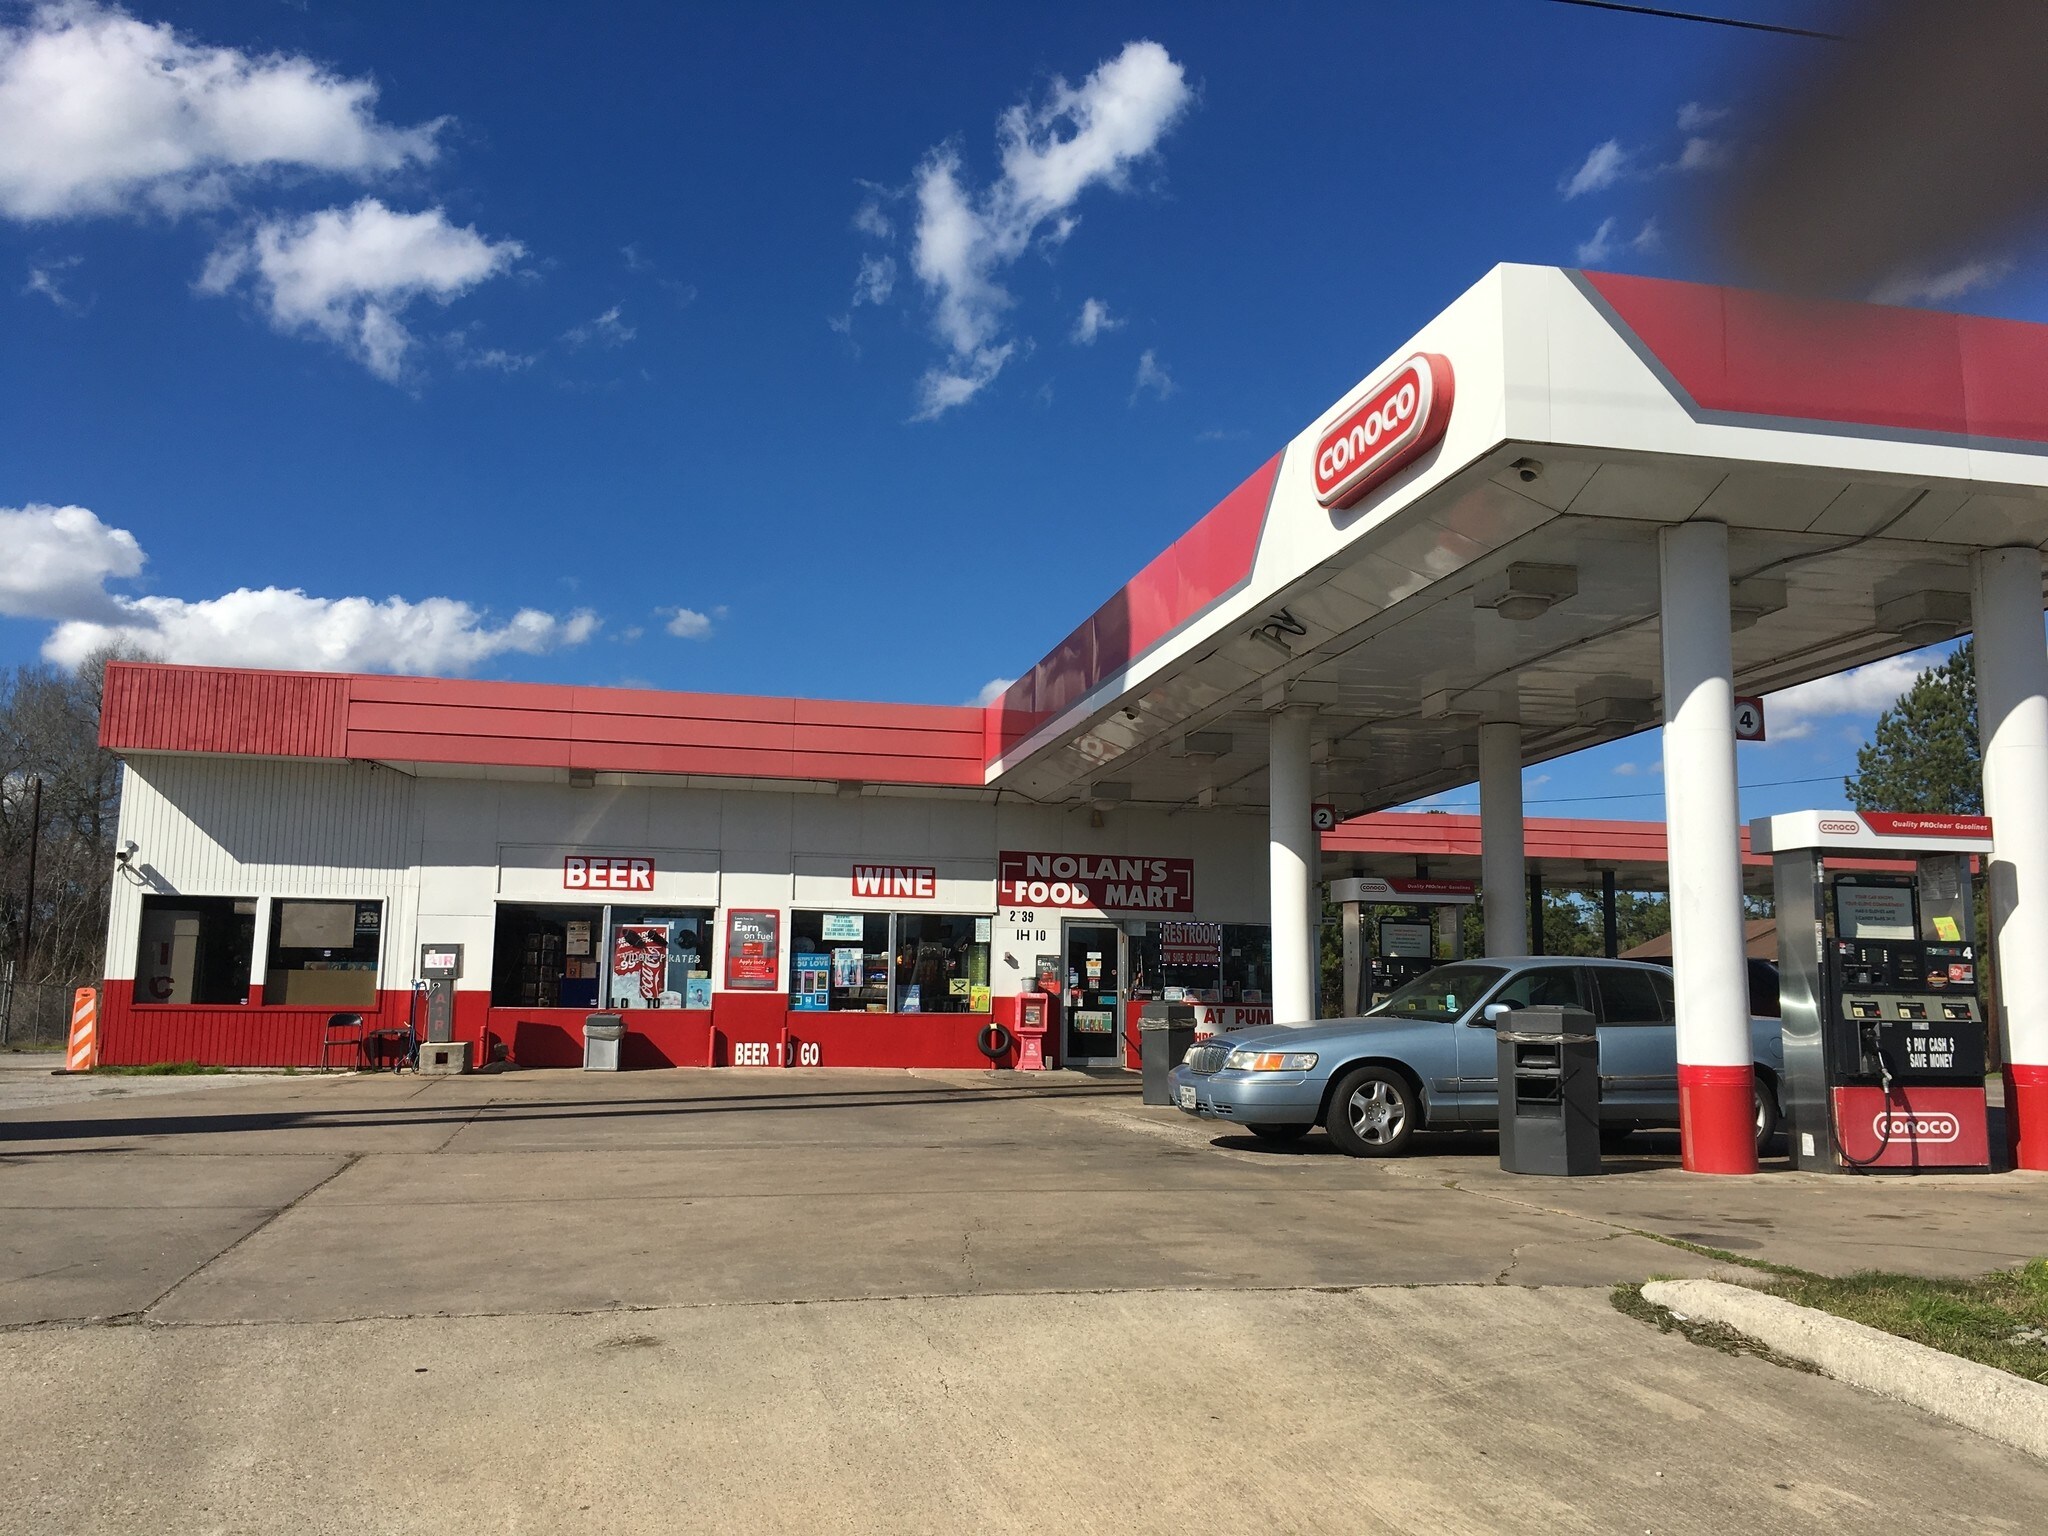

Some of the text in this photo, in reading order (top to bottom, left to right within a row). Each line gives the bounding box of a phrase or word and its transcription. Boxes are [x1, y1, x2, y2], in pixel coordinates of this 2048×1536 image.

[1319, 383, 1416, 480] conoco
[1740, 711, 1754, 728] 4
[1318, 812, 1328, 824] 2
[1892, 820, 1918, 830] Quality
[1955, 822, 1988, 831] Gasolines
[1822, 823, 1856, 832] conoco
[566, 858, 652, 888] BEER
[1026, 855, 1168, 882] NOLAN'S
[855, 867, 933, 896] WINE
[1014, 880, 1178, 908] FOOD MART
[734, 921, 759, 932] Earn
[757, 931, 773, 940] fuel
[1163, 925, 1219, 944] RESTROOM
[659, 954, 701, 964] PRATES
[1173, 953, 1184, 962] SIDE
[1187, 953, 1193, 962] OF
[1195, 953, 1218, 963] BUILDING
[1962, 947, 1973, 960] 4
[434, 993, 447, 1031] AIR
[1203, 1008, 1273, 1025] AT PUM
[1913, 1037, 1926, 1052] PAY
[1928, 1037, 1947, 1052] CASH
[734, 1042, 769, 1066] BEER
[800, 1042, 820, 1066] GO
[1910, 1053, 1953, 1068] SAVE MONEY
[1880, 1120, 1953, 1134] conoco
